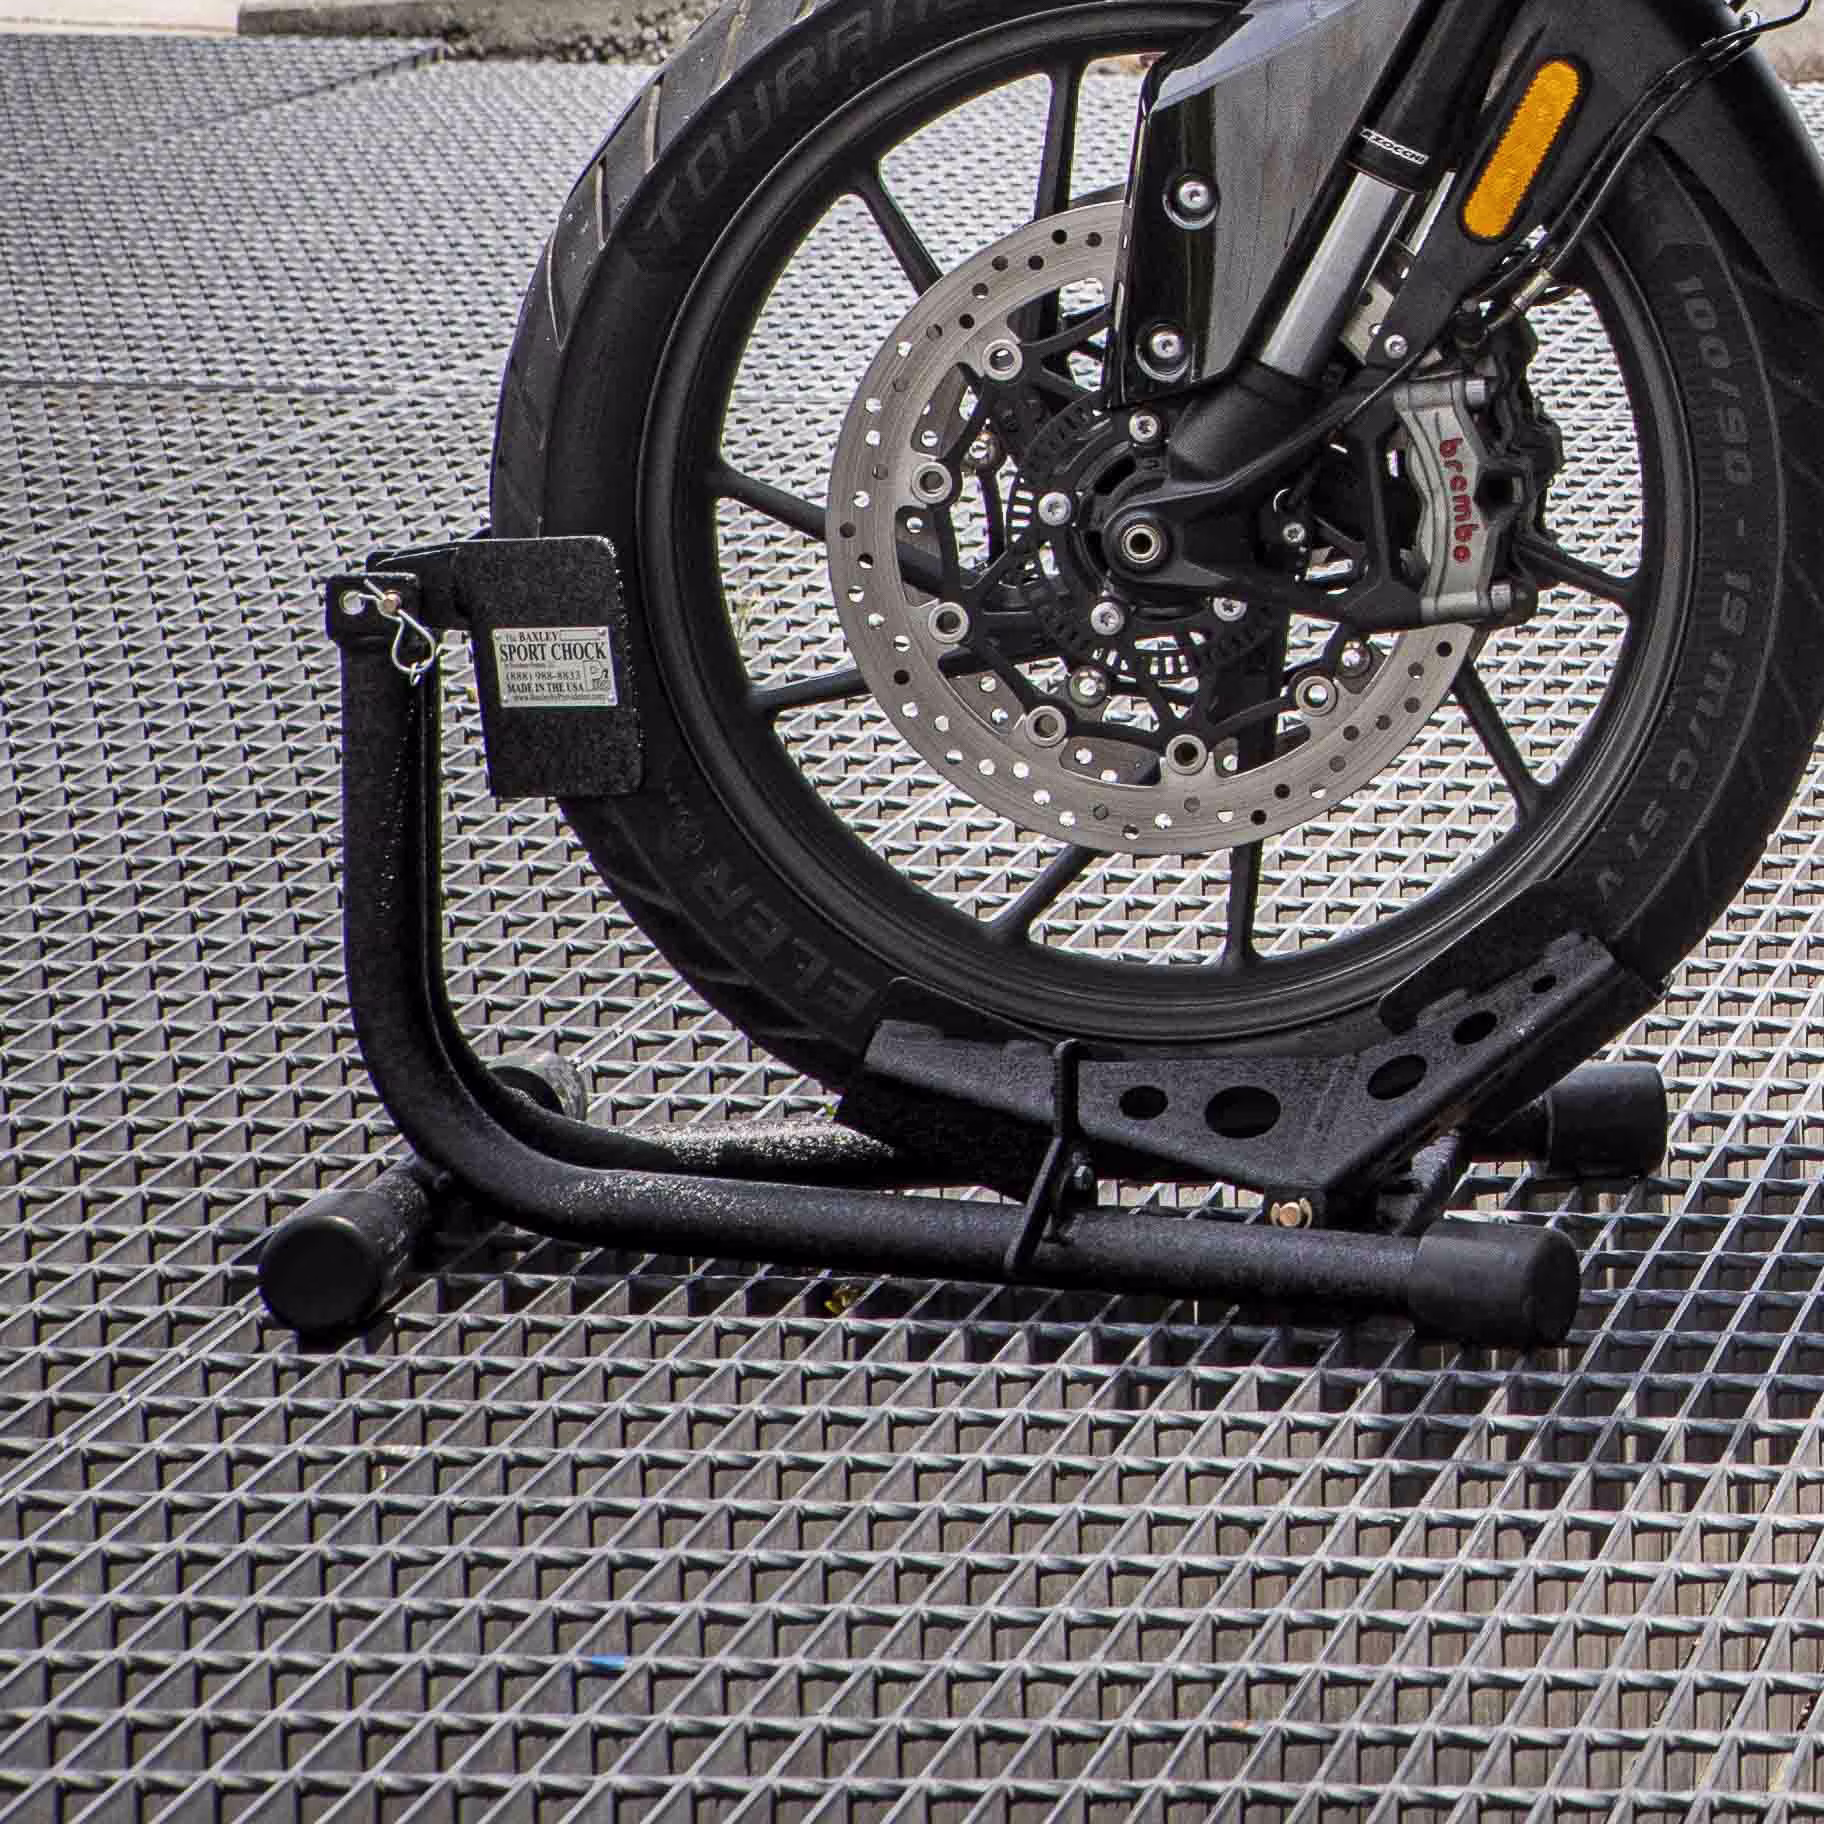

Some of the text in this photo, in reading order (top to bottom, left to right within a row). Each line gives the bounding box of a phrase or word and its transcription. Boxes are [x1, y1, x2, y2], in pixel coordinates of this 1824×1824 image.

[1439, 436, 1480, 563] brembo
[519, 631, 560, 643] BAXLEY
[500, 641, 607, 662] SPORT CHOCK
[507, 682, 585, 694] MADE IN THE USA
